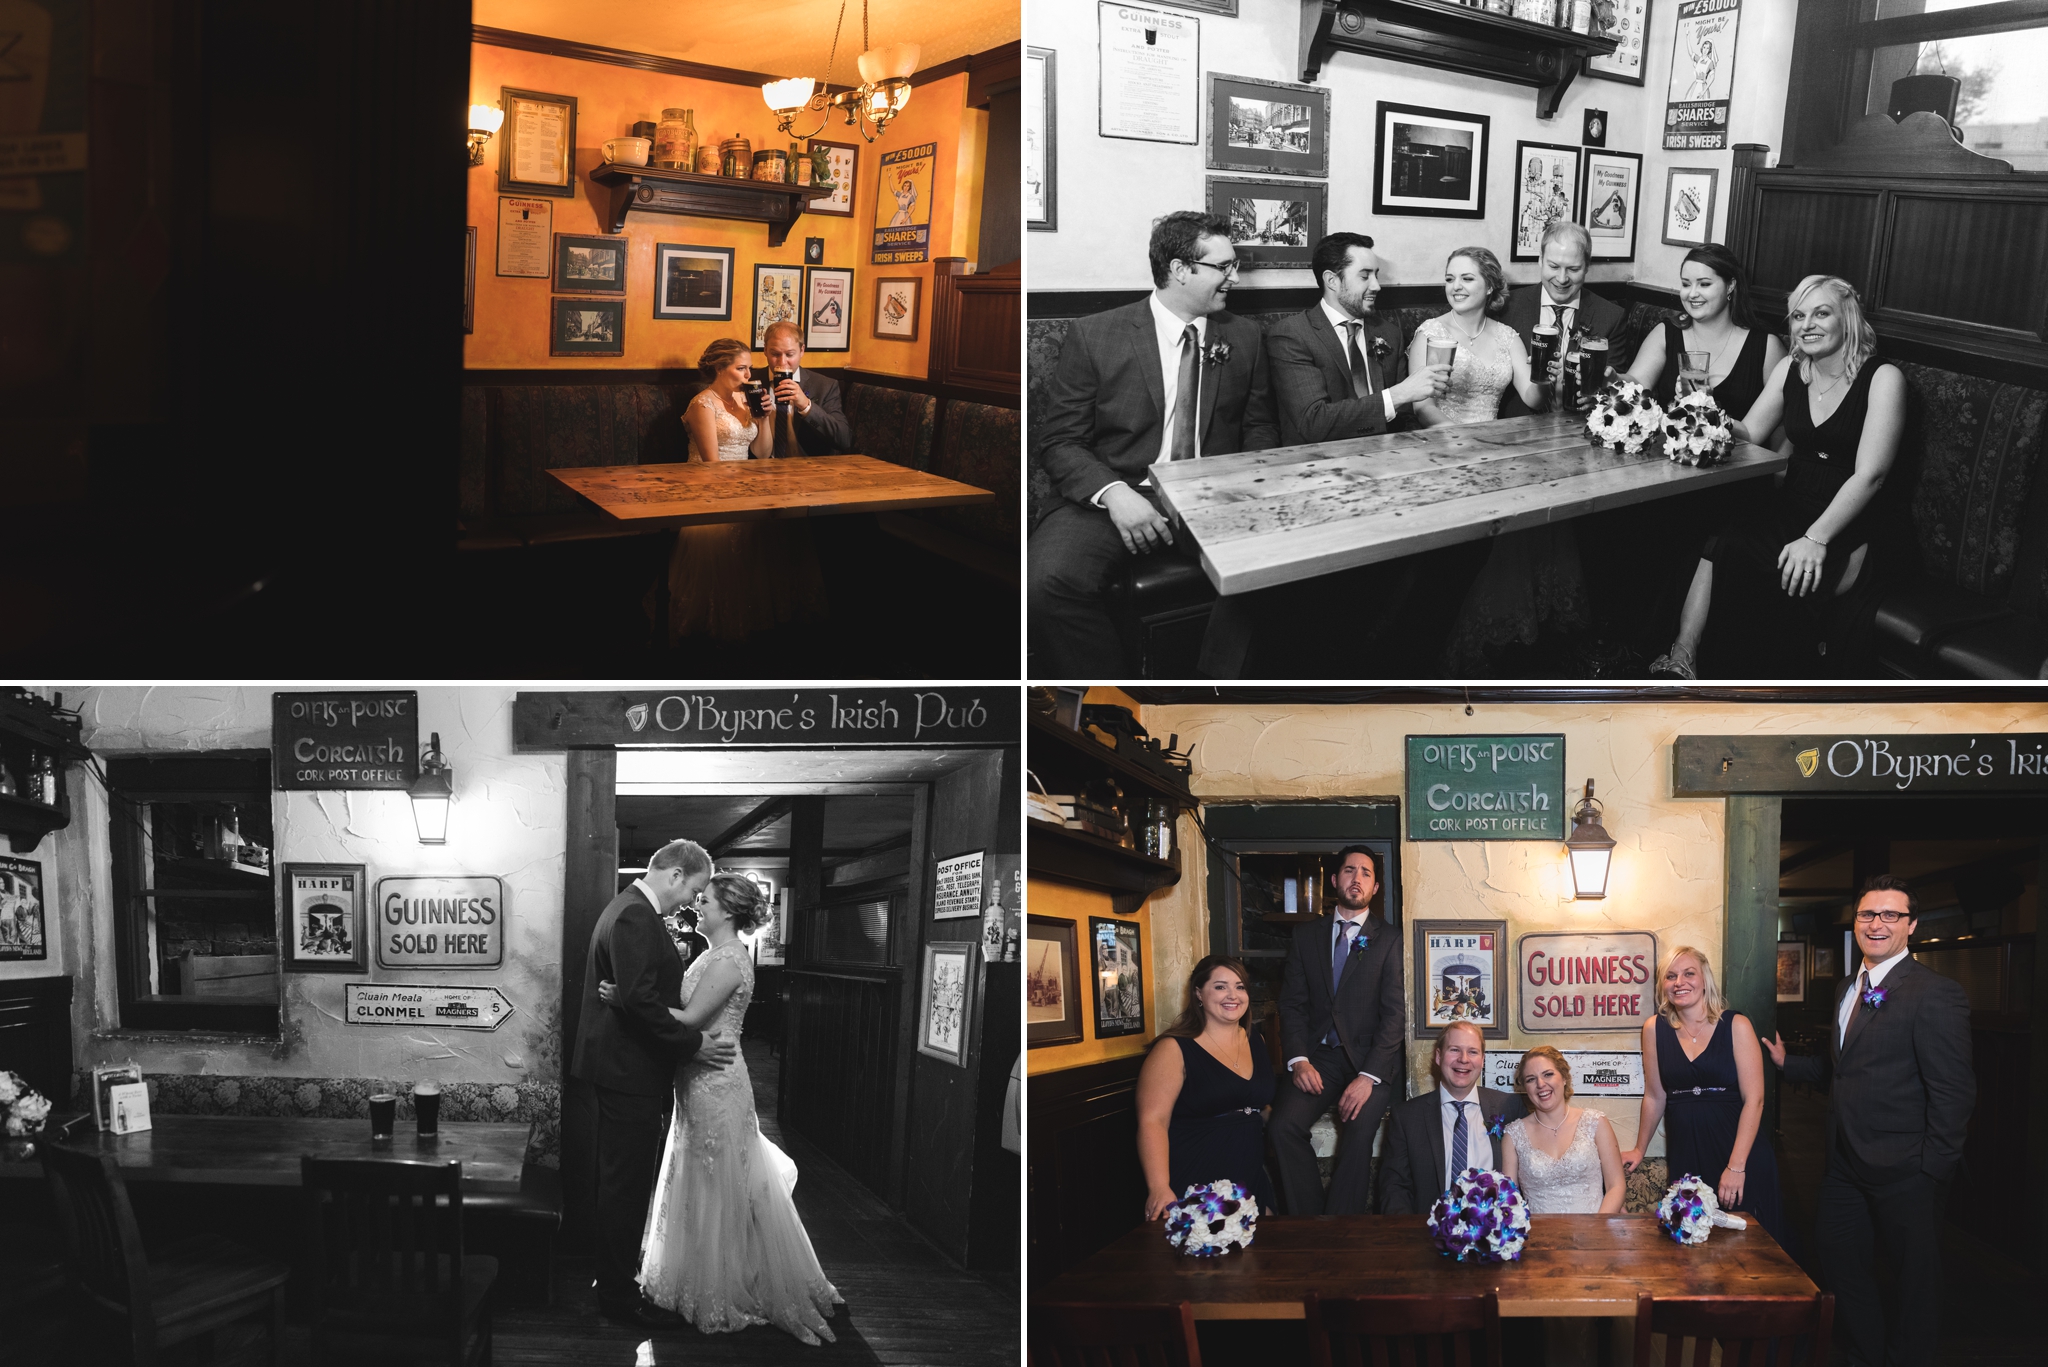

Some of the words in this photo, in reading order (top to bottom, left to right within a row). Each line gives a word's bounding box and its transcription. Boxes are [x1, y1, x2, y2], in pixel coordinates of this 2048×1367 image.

[1118, 9, 1182, 30] GUINNESS
[1695, 18, 1715, 26] MIGHT
[1121, 26, 1141, 34] EXTRA
[1160, 32, 1180, 40] STOUT
[1147, 46, 1170, 54] PORTER
[1132, 54, 1168, 66] DRAUGHT
[1678, 108, 1714, 122] SHARES
[1666, 136, 1686, 148] IRISH
[1688, 134, 1722, 148] SWEEPS
[1597, 170, 1604, 178] My
[1604, 170, 1624, 179] Goodness
[1598, 179, 1605, 187] My
[509, 200, 543, 208] GUINNESS
[884, 231, 917, 242] SHARES
[875, 253, 892, 262] IRISH
[894, 251, 924, 262] SWEEPS
[656, 694, 816, 742] O'Byrne's
[830, 694, 899, 730] Irish
[914, 692, 988, 739] Pub
[1827, 738, 1994, 790] O'Byrne's
[2007, 739, 2048, 776] Iri
[296, 769, 326, 781] CORK
[328, 768, 358, 781] POST
[361, 768, 404, 781] OFFICE
[1430, 818, 1462, 832] CORK
[1465, 818, 1499, 832] POST
[1502, 818, 1548, 832] OFFICE
[18, 864, 36, 873] BRAGH
[937, 865, 953, 875] POST
[954, 859, 980, 872] OFFICE
[298, 880, 340, 889] HARP
[384, 892, 496, 926] GUINNESS
[1120, 926, 1135, 935] BRAGH
[389, 933, 438, 955] SOLD
[444, 934, 488, 954] HERE
[1430, 938, 1477, 948] HARP
[1527, 950, 1650, 987] GUINNESS
[356, 992, 388, 1002] Cluain
[392, 992, 423, 1002] Meala
[492, 1002, 500, 1013] 5
[1532, 994, 1586, 1018] SOLD
[1593, 994, 1641, 1017] HERE
[356, 1006, 426, 1018] CLONMEL
[438, 1008, 478, 1016] MAGNERS
[1496, 1060, 1520, 1070] Clua
[1584, 1076, 1630, 1084] MAGNERS
